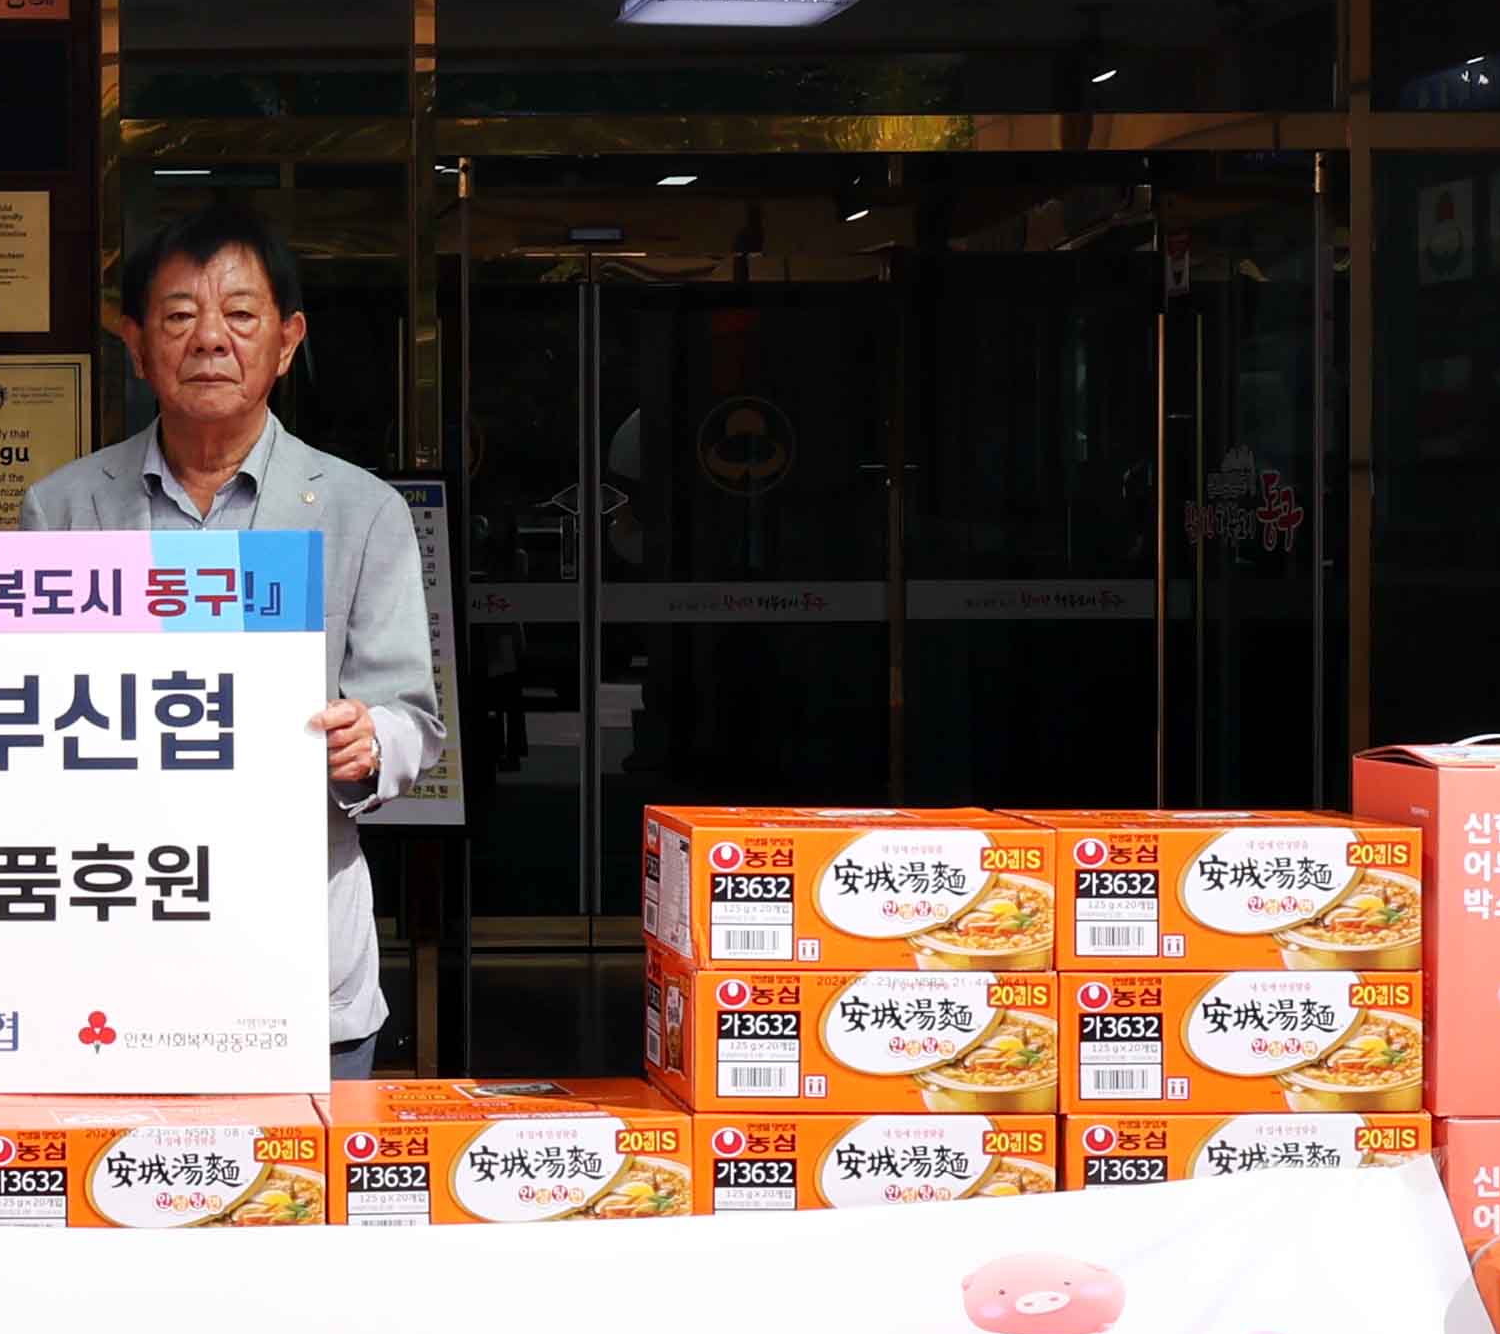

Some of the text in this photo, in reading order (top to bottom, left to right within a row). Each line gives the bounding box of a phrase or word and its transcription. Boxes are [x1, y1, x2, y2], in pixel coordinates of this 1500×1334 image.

[10, 430, 30, 439] that
[9, 473, 24, 483] the
[744, 849, 793, 867] 농심
[715, 871, 790, 899] 가3632
[834, 859, 966, 895] 安城湯麵
[1112, 982, 1161, 1007] 농심
[1084, 1011, 1159, 1039] 가3632
[1203, 997, 1336, 1033] 安城湯麵
[123, 1030, 154, 1049] 인천
[107, 1152, 241, 1187] 安城湯麵
